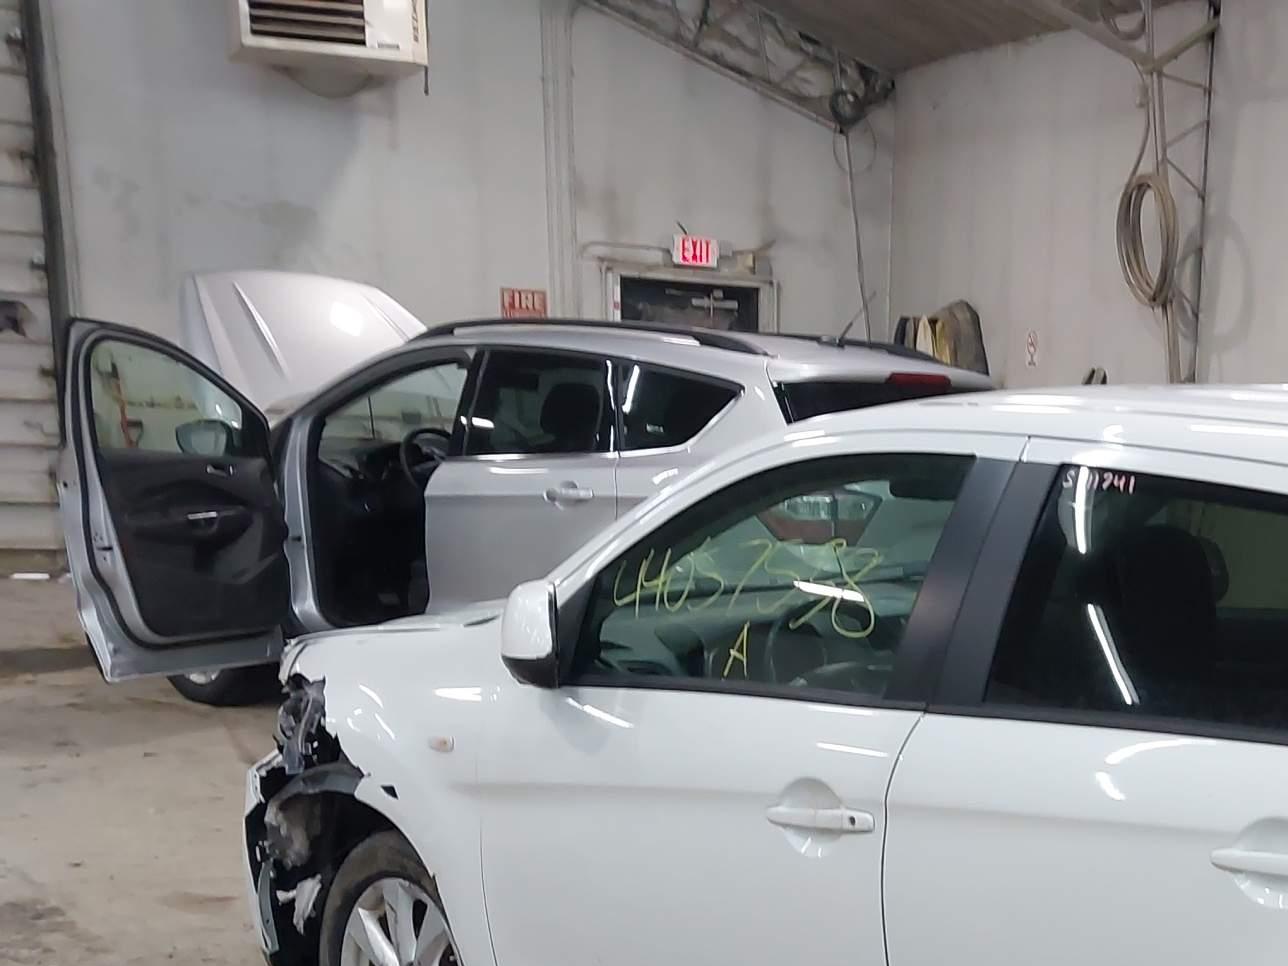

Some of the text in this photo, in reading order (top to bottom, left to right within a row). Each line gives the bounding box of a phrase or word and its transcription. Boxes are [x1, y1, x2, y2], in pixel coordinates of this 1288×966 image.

[681, 238, 712, 264] EXIT
[502, 290, 546, 311] FIRE
[722, 620, 750, 680] A
